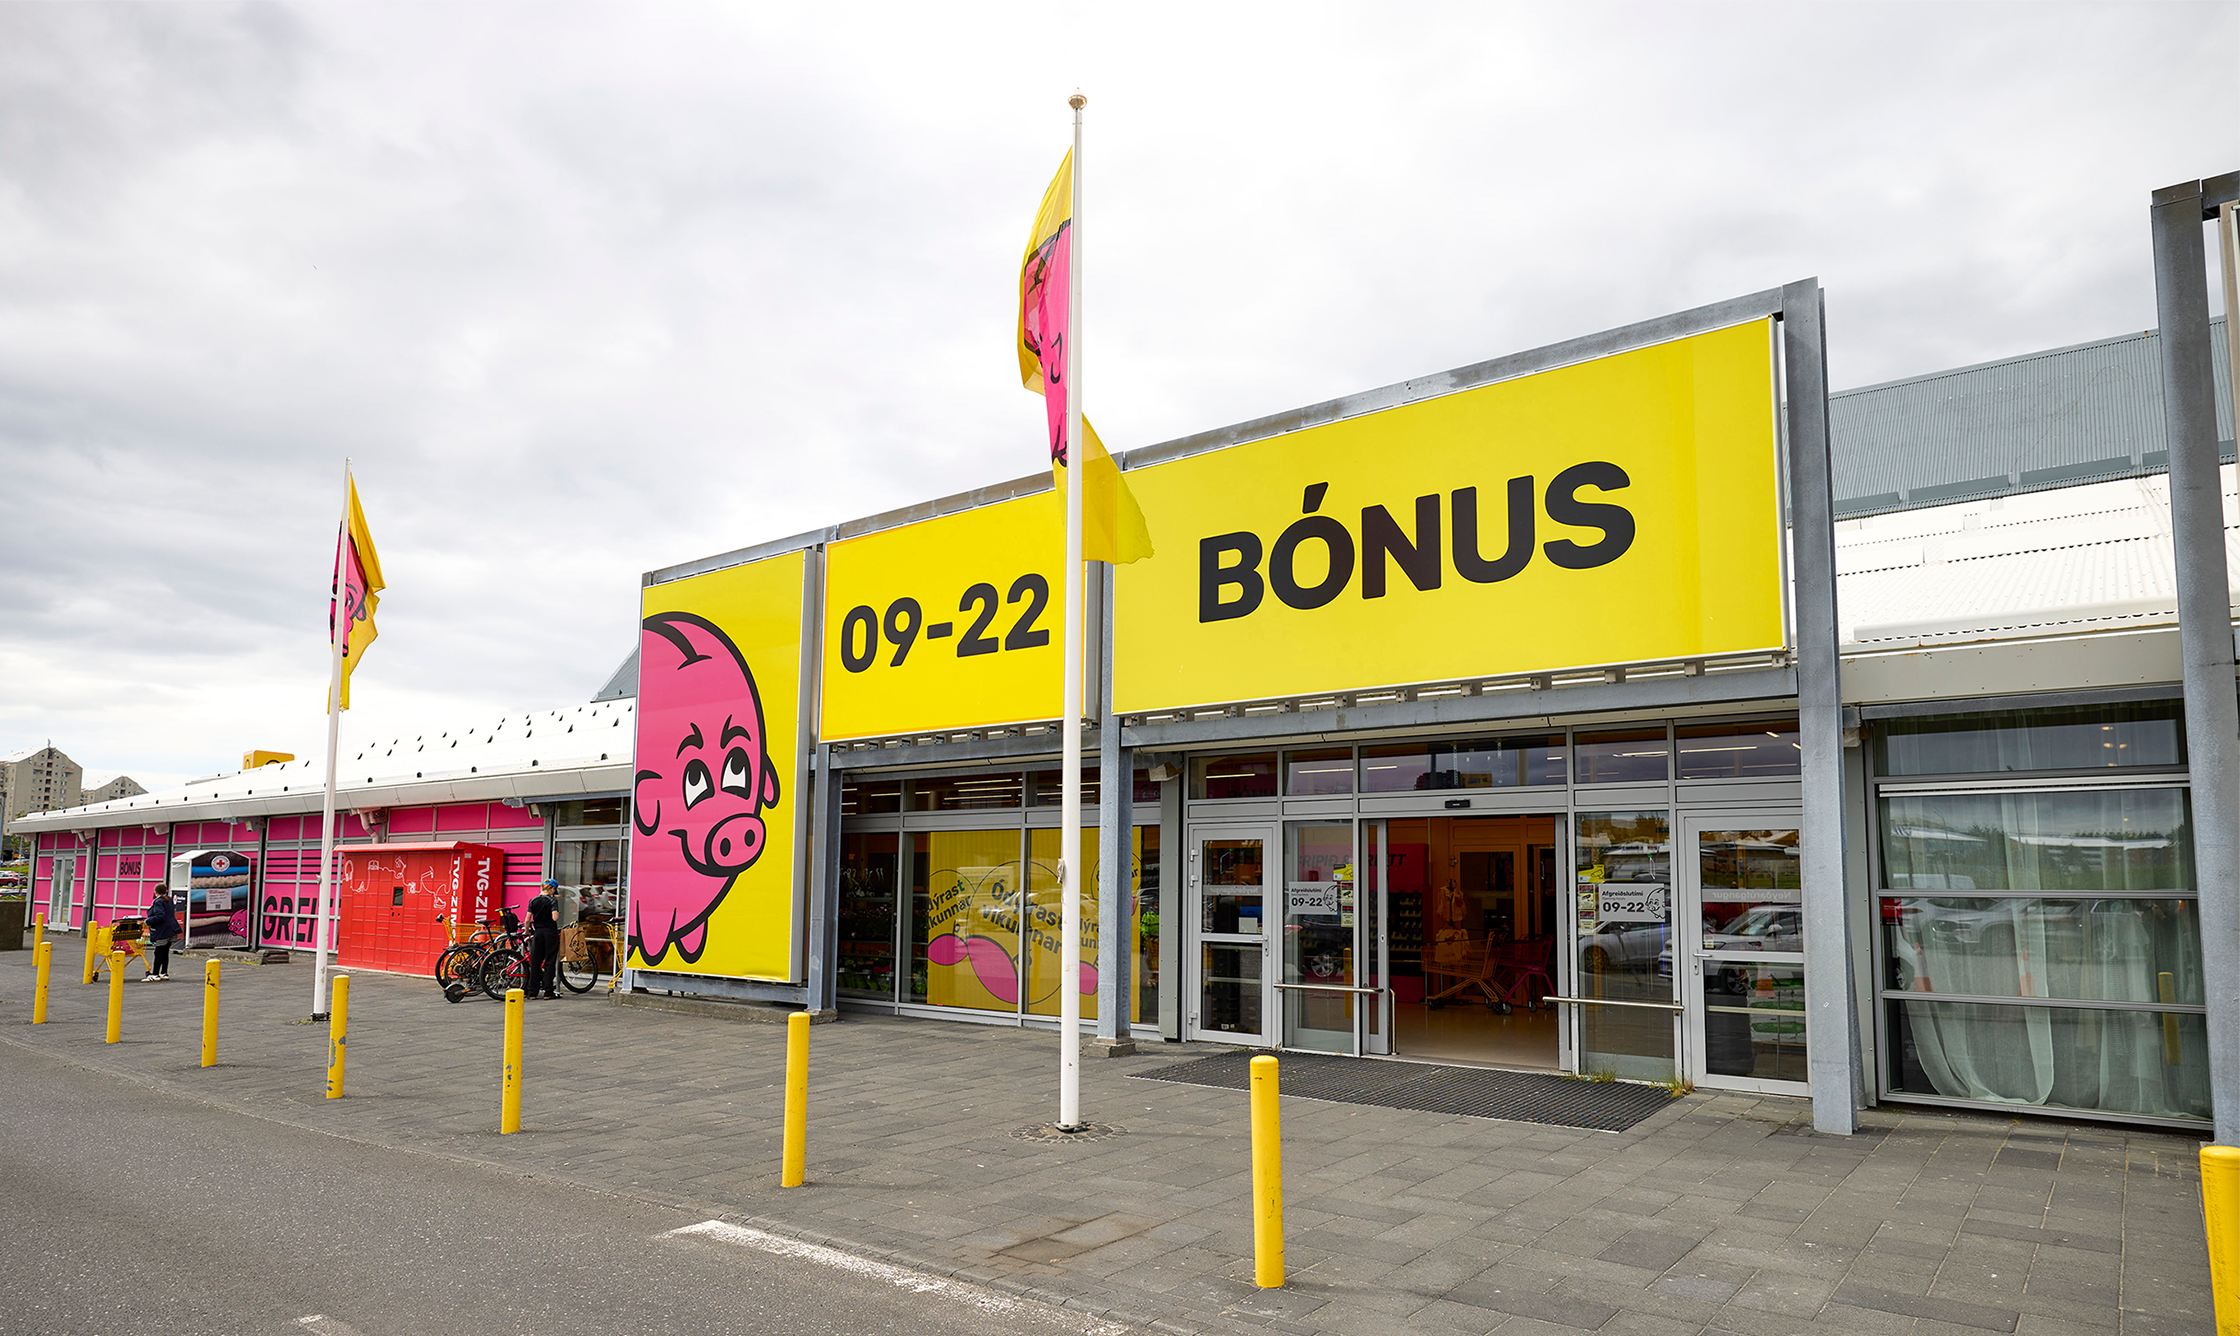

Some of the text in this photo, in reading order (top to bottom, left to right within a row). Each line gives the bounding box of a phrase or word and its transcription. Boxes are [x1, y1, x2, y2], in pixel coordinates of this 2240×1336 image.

[1199, 460, 1636, 623] BÓNUS
[840, 573, 1050, 673] 09-22
[120, 857, 141, 875] BÓNUS
[262, 895, 341, 944] GREI
[448, 856, 460, 947] TVG-ZIM
[929, 896, 971, 930] kunnar
[1291, 897, 1323, 906] 09-22
[1602, 901, 1645, 912] 09-22
